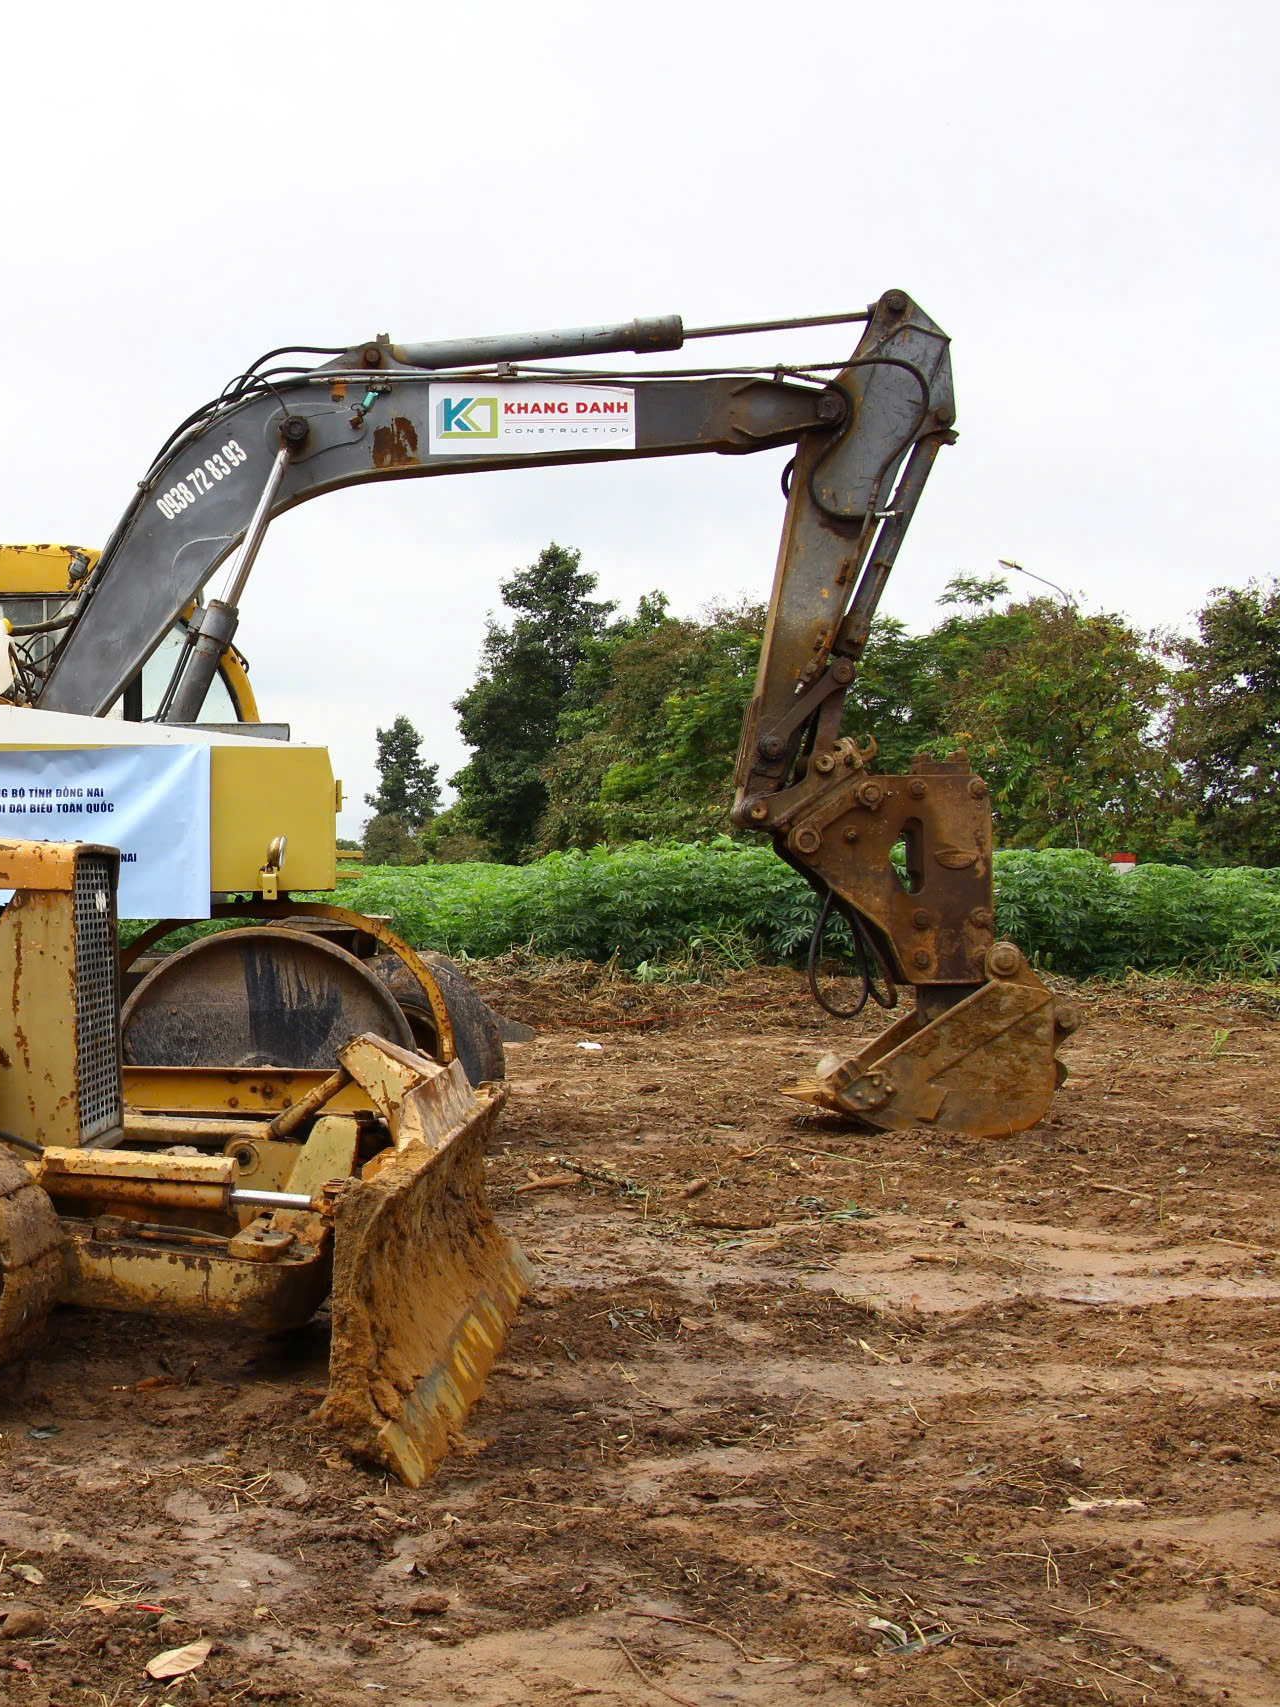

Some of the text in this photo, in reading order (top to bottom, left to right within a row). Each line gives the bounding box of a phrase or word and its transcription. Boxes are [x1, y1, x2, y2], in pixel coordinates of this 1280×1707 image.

[504, 401, 629, 415] KHANG DANH
[156, 439, 248, 520] 0938 72 83 93
[11, 787, 26, 800] BỘ
[87, 787, 104, 798] NAI
[9, 804, 27, 815] ĐẠI
[56, 801, 83, 813] TOÀN
[86, 801, 115, 814] QUỐC
[121, 853, 137, 863] NAI
